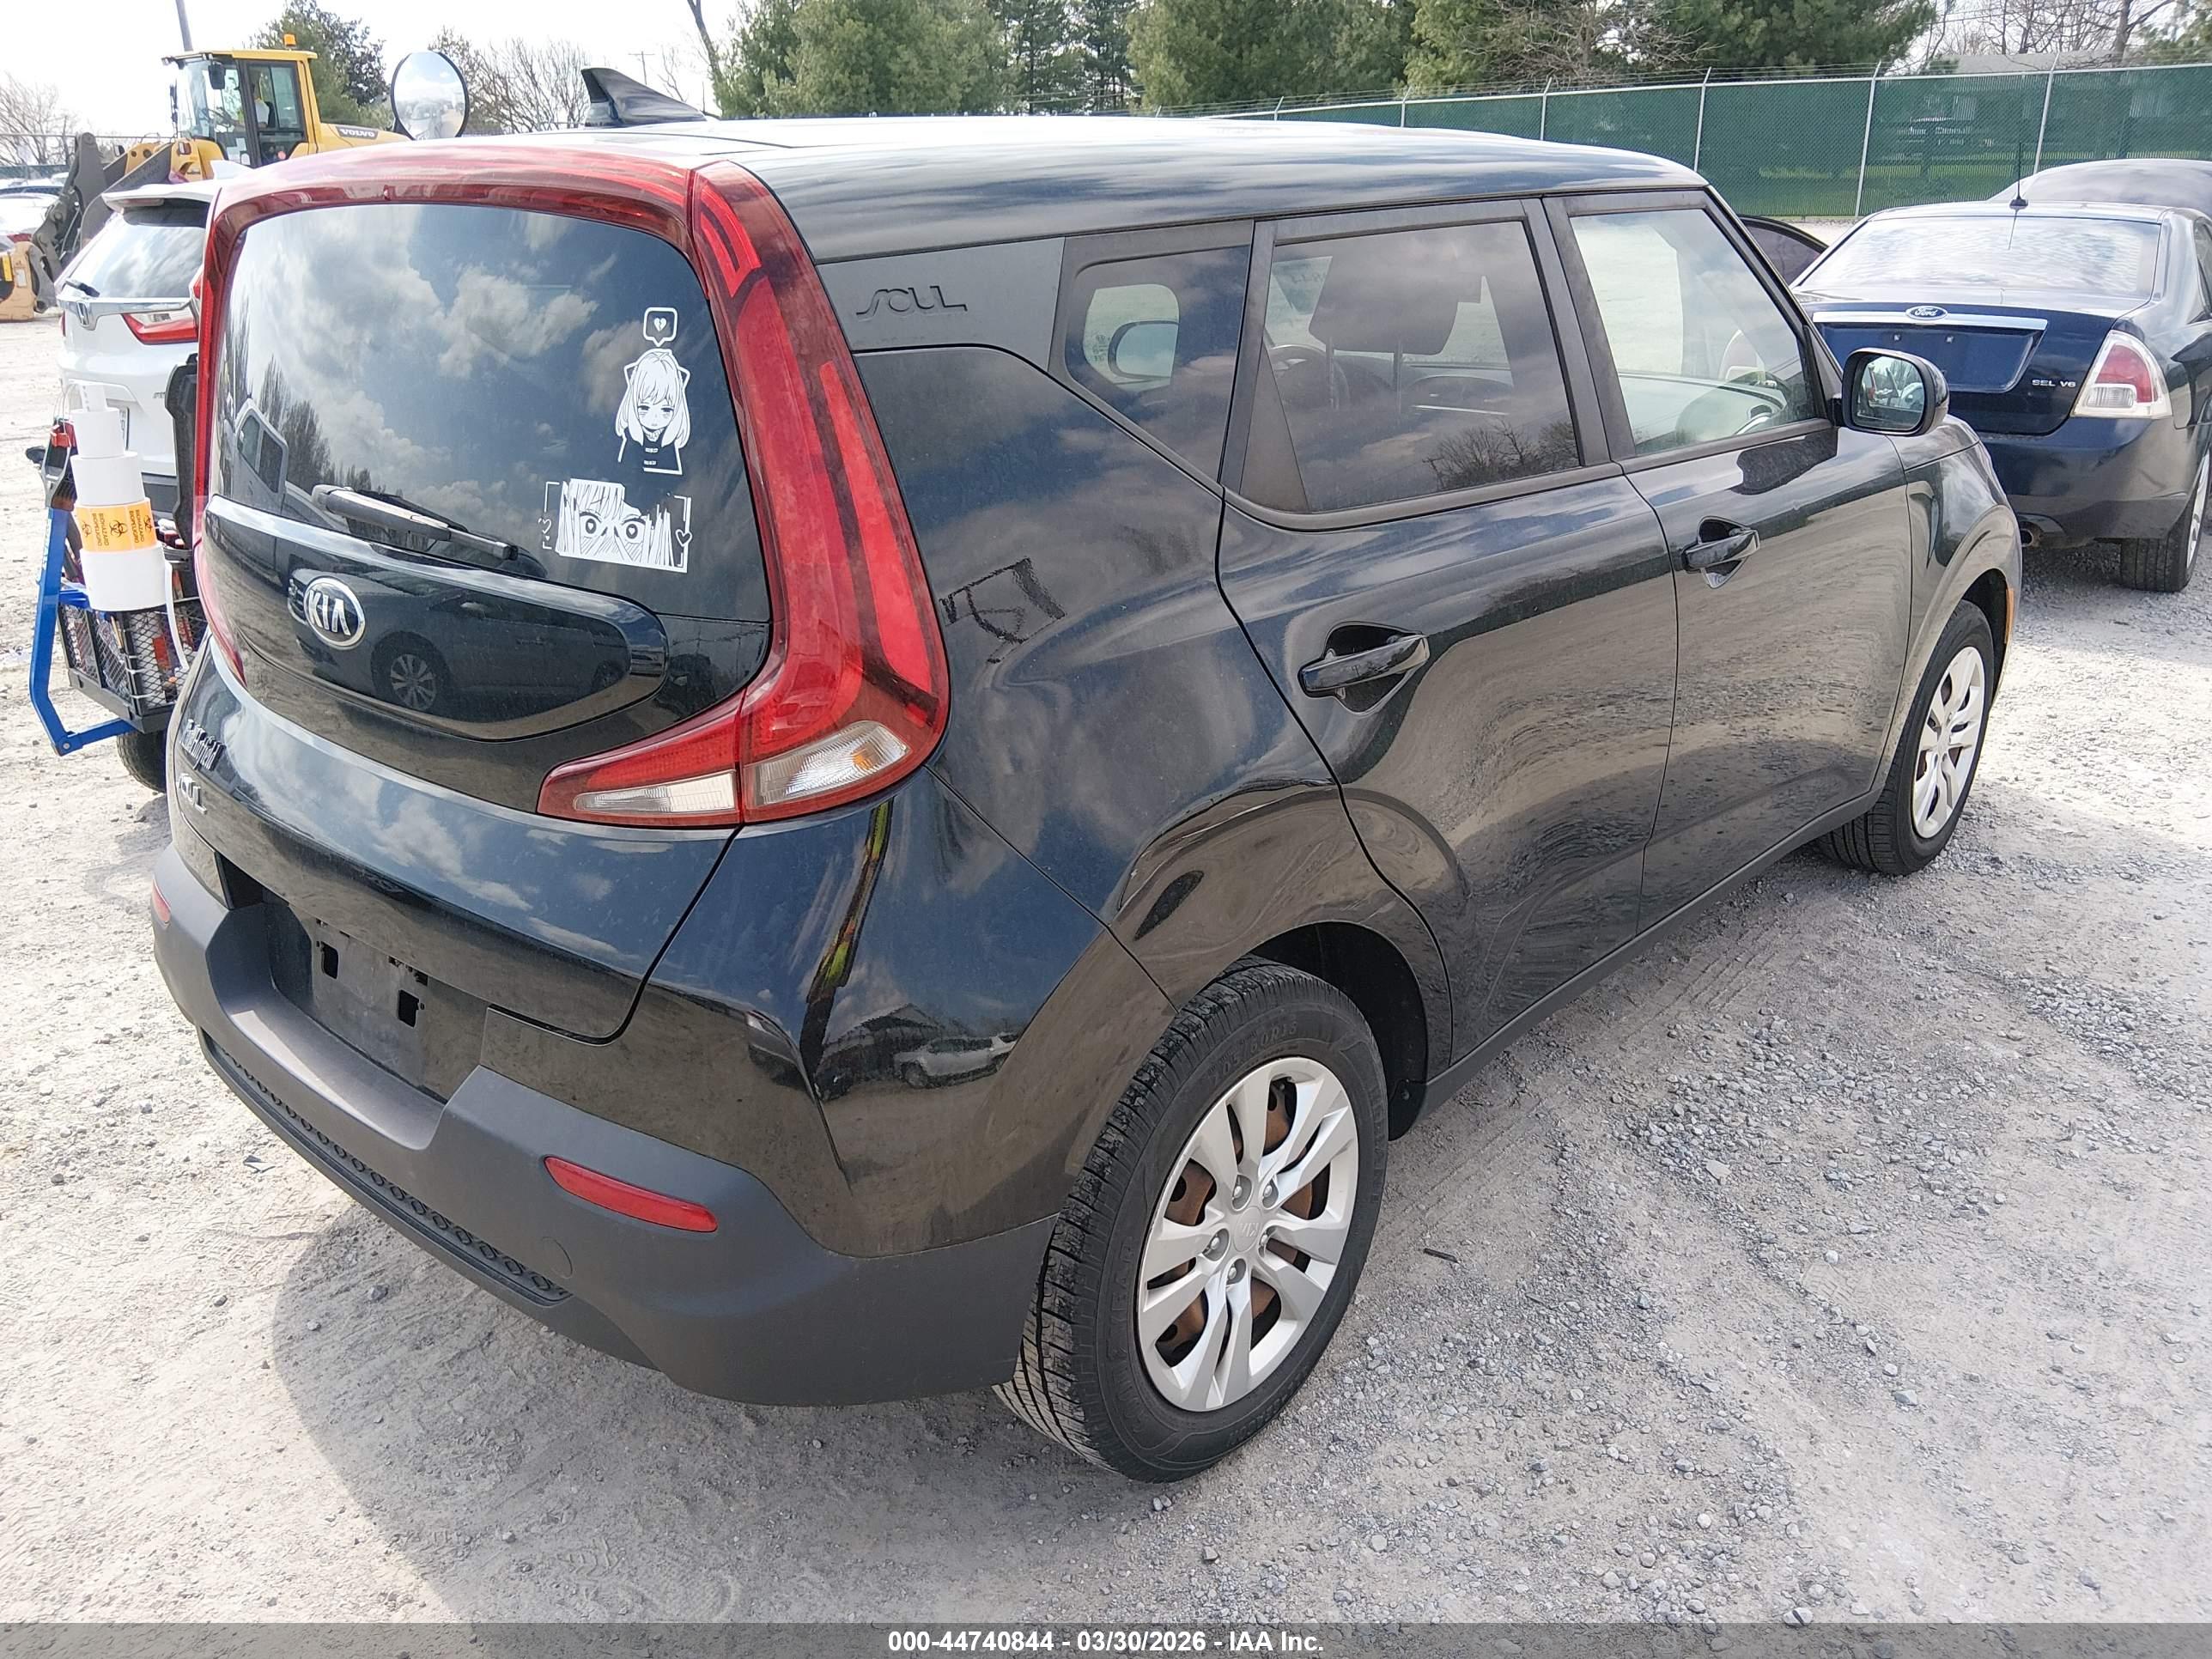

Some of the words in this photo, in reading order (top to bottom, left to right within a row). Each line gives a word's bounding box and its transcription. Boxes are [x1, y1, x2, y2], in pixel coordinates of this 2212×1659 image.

[339, 128, 375, 137] VOLVO
[855, 284, 968, 319] SOUL
[129, 510, 139, 544] BIOPELIGRO
[135, 509, 145, 543] BIOHAZARD
[307, 589, 351, 636] KIA
